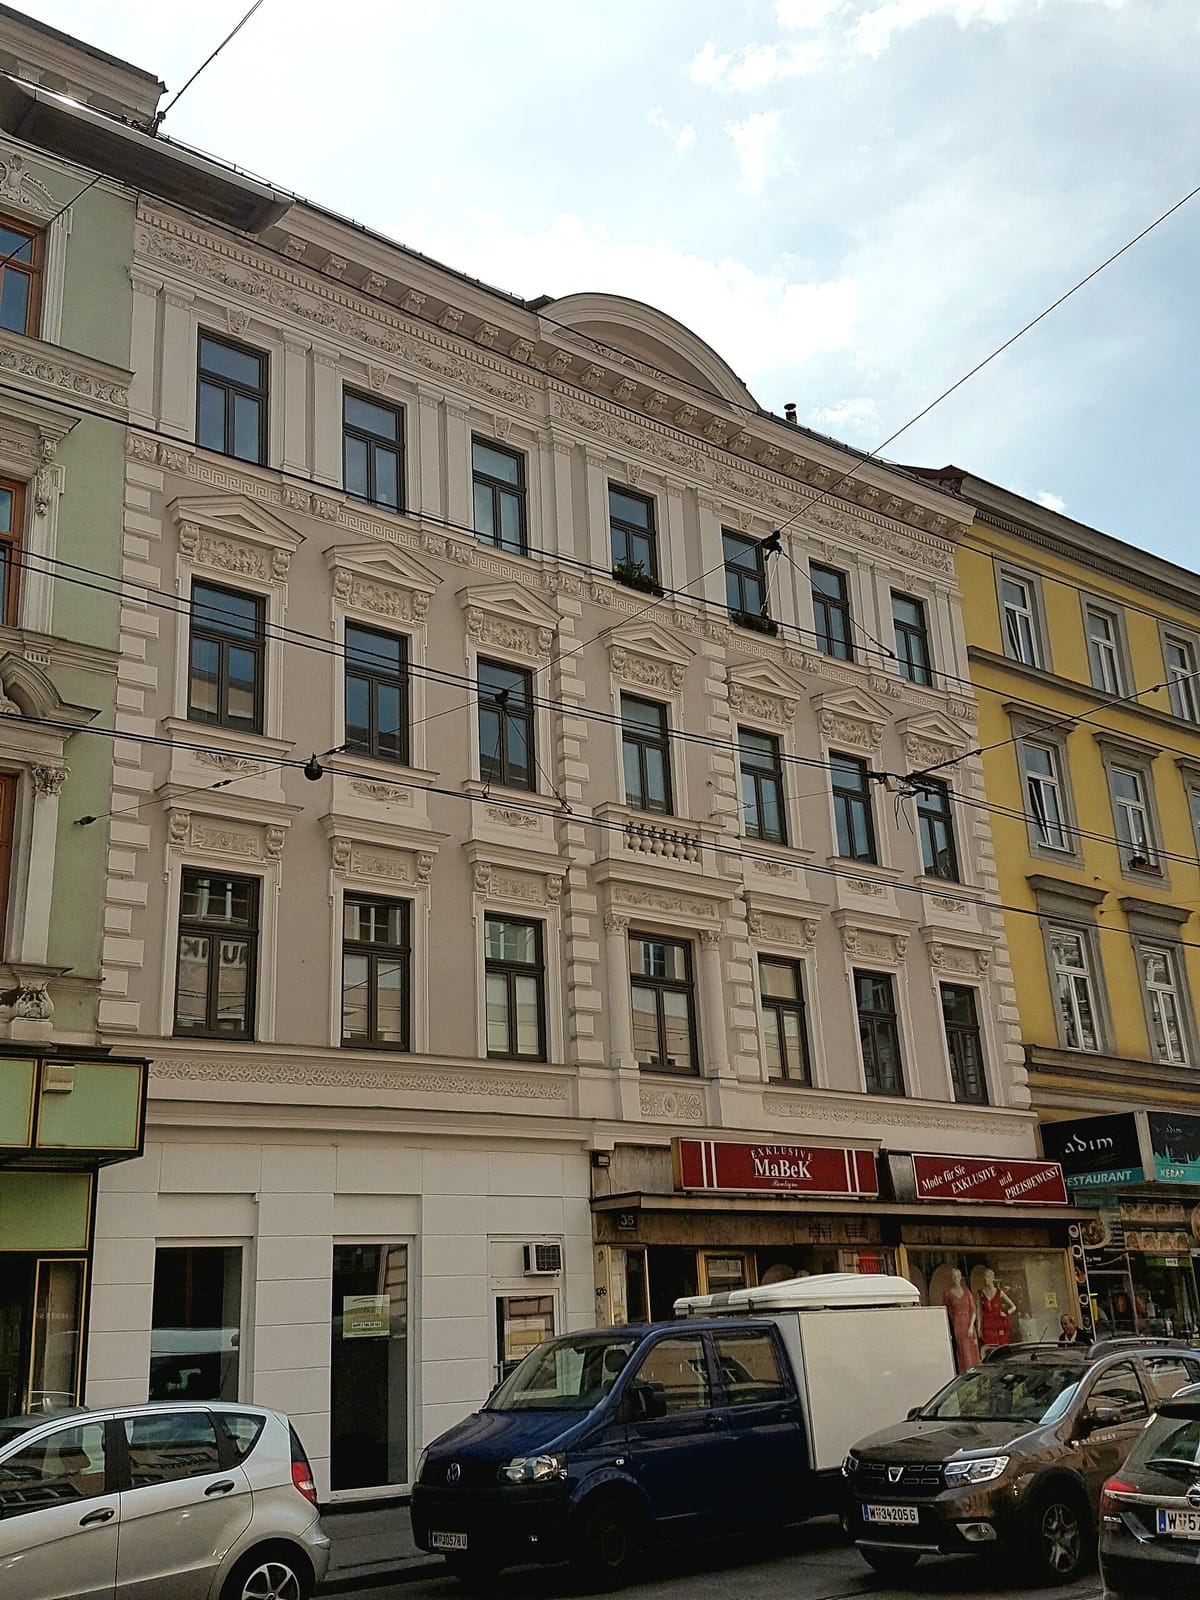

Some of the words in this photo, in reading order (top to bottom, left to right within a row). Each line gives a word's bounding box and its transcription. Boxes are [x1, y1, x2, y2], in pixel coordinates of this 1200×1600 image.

[750, 1146, 814, 1162] EXKLUSIVE
[753, 1158, 812, 1178] MaBeK
[921, 1175, 943, 1192] Mode
[943, 1169, 955, 1182] für
[954, 1164, 966, 1176] Sie
[950, 1165, 997, 1195] EXKLUSIVE
[999, 1172, 1014, 1187] und
[1004, 1165, 1060, 1200] PREISBEWUSST
[620, 1214, 635, 1226] 35
[1167, 1512, 1178, 1530] W
